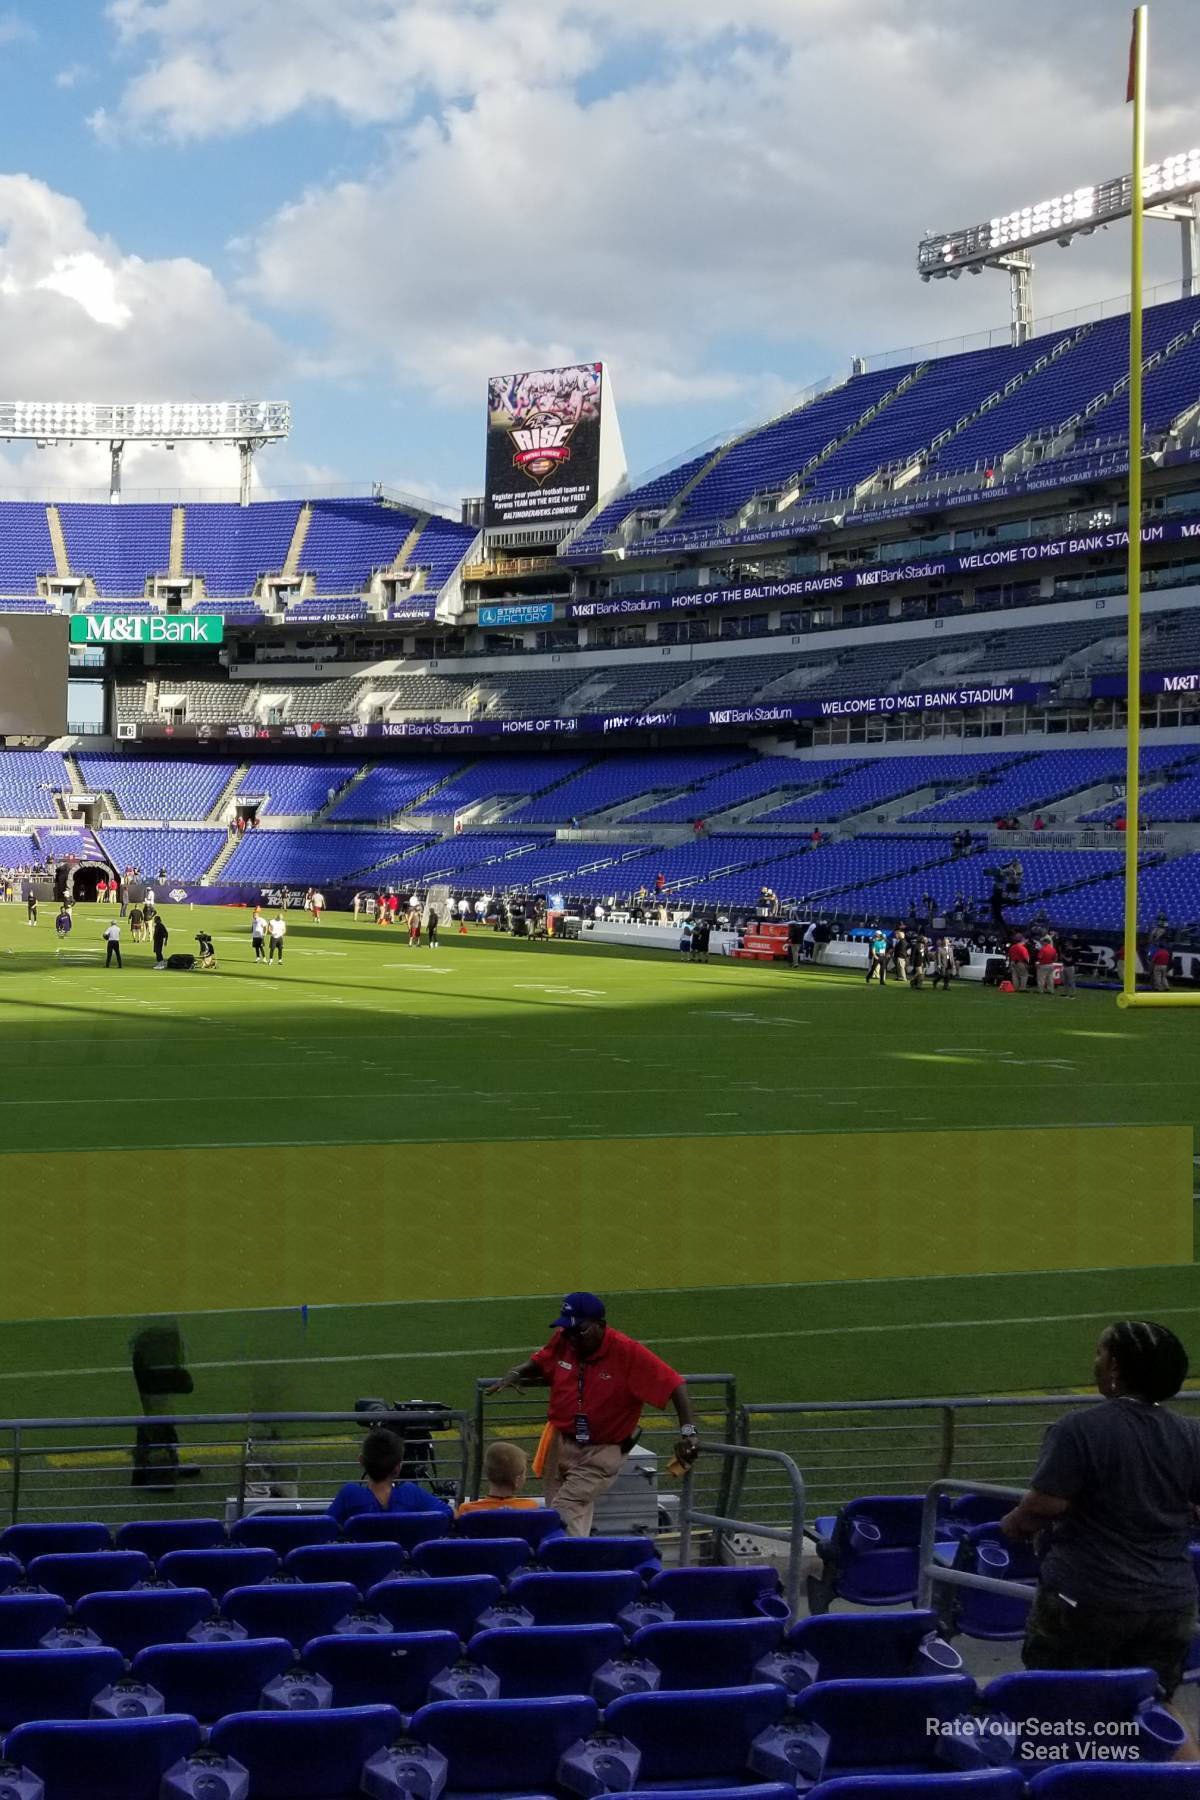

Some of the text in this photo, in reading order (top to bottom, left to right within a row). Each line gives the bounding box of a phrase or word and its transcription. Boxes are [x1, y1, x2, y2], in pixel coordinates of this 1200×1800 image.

[512, 424, 574, 450] RISE
[1026, 479, 1057, 490] MICHAEL
[1094, 463, 1130, 477] 1997-200
[492, 493, 513, 502] Register
[514, 492, 526, 500] your
[527, 490, 541, 499] youth
[542, 487, 563, 496] football
[494, 502, 513, 510] Ravens
[514, 500, 528, 508] TEAM
[959, 526, 1163, 569] WELCOME TO M&T BANK STAIUM
[856, 563, 945, 586] M&T Bank Stadium
[672, 575, 844, 607] HOME OF THE BALTIMORE RAVENS
[393, 611, 430, 619] RAVENS
[497, 604, 547, 615] STRATEGIC
[572, 600, 661, 617] M&T Bank Stadium
[497, 612, 547, 624] FACTORY
[86, 616, 208, 641] M&T Bank
[1163, 675, 1198, 691] M&T
[821, 688, 1013, 714] WELCOME TO M&T BANK STADIUM
[709, 707, 792, 724] M&T Bank Stadium
[382, 723, 473, 735] M&T Bank Stadium
[502, 721, 533, 731] HOME
[535, 720, 550, 730] OF
